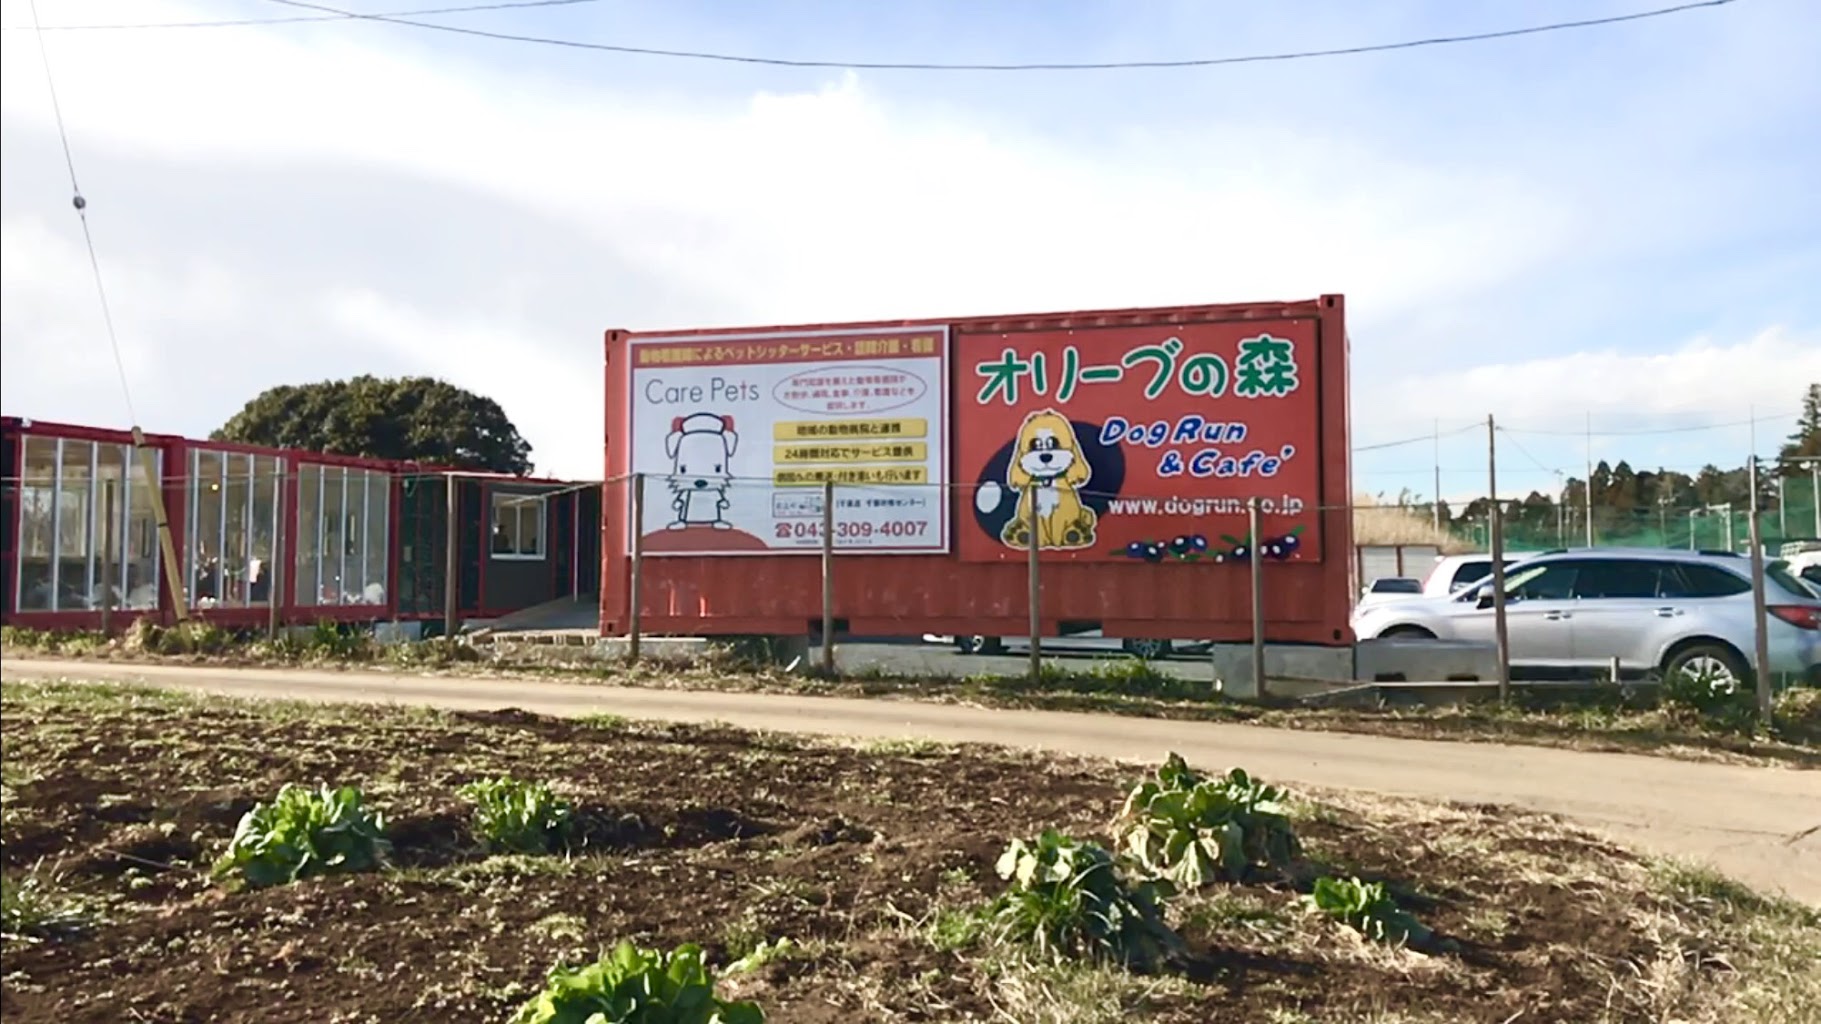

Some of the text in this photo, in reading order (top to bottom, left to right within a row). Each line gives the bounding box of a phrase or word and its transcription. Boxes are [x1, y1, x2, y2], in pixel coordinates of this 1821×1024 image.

[976, 333, 1299, 405] オリーブの森
[645, 377, 760, 405] Care Pets
[1099, 414, 1248, 446] Dog Run
[1157, 451, 1184, 477] &
